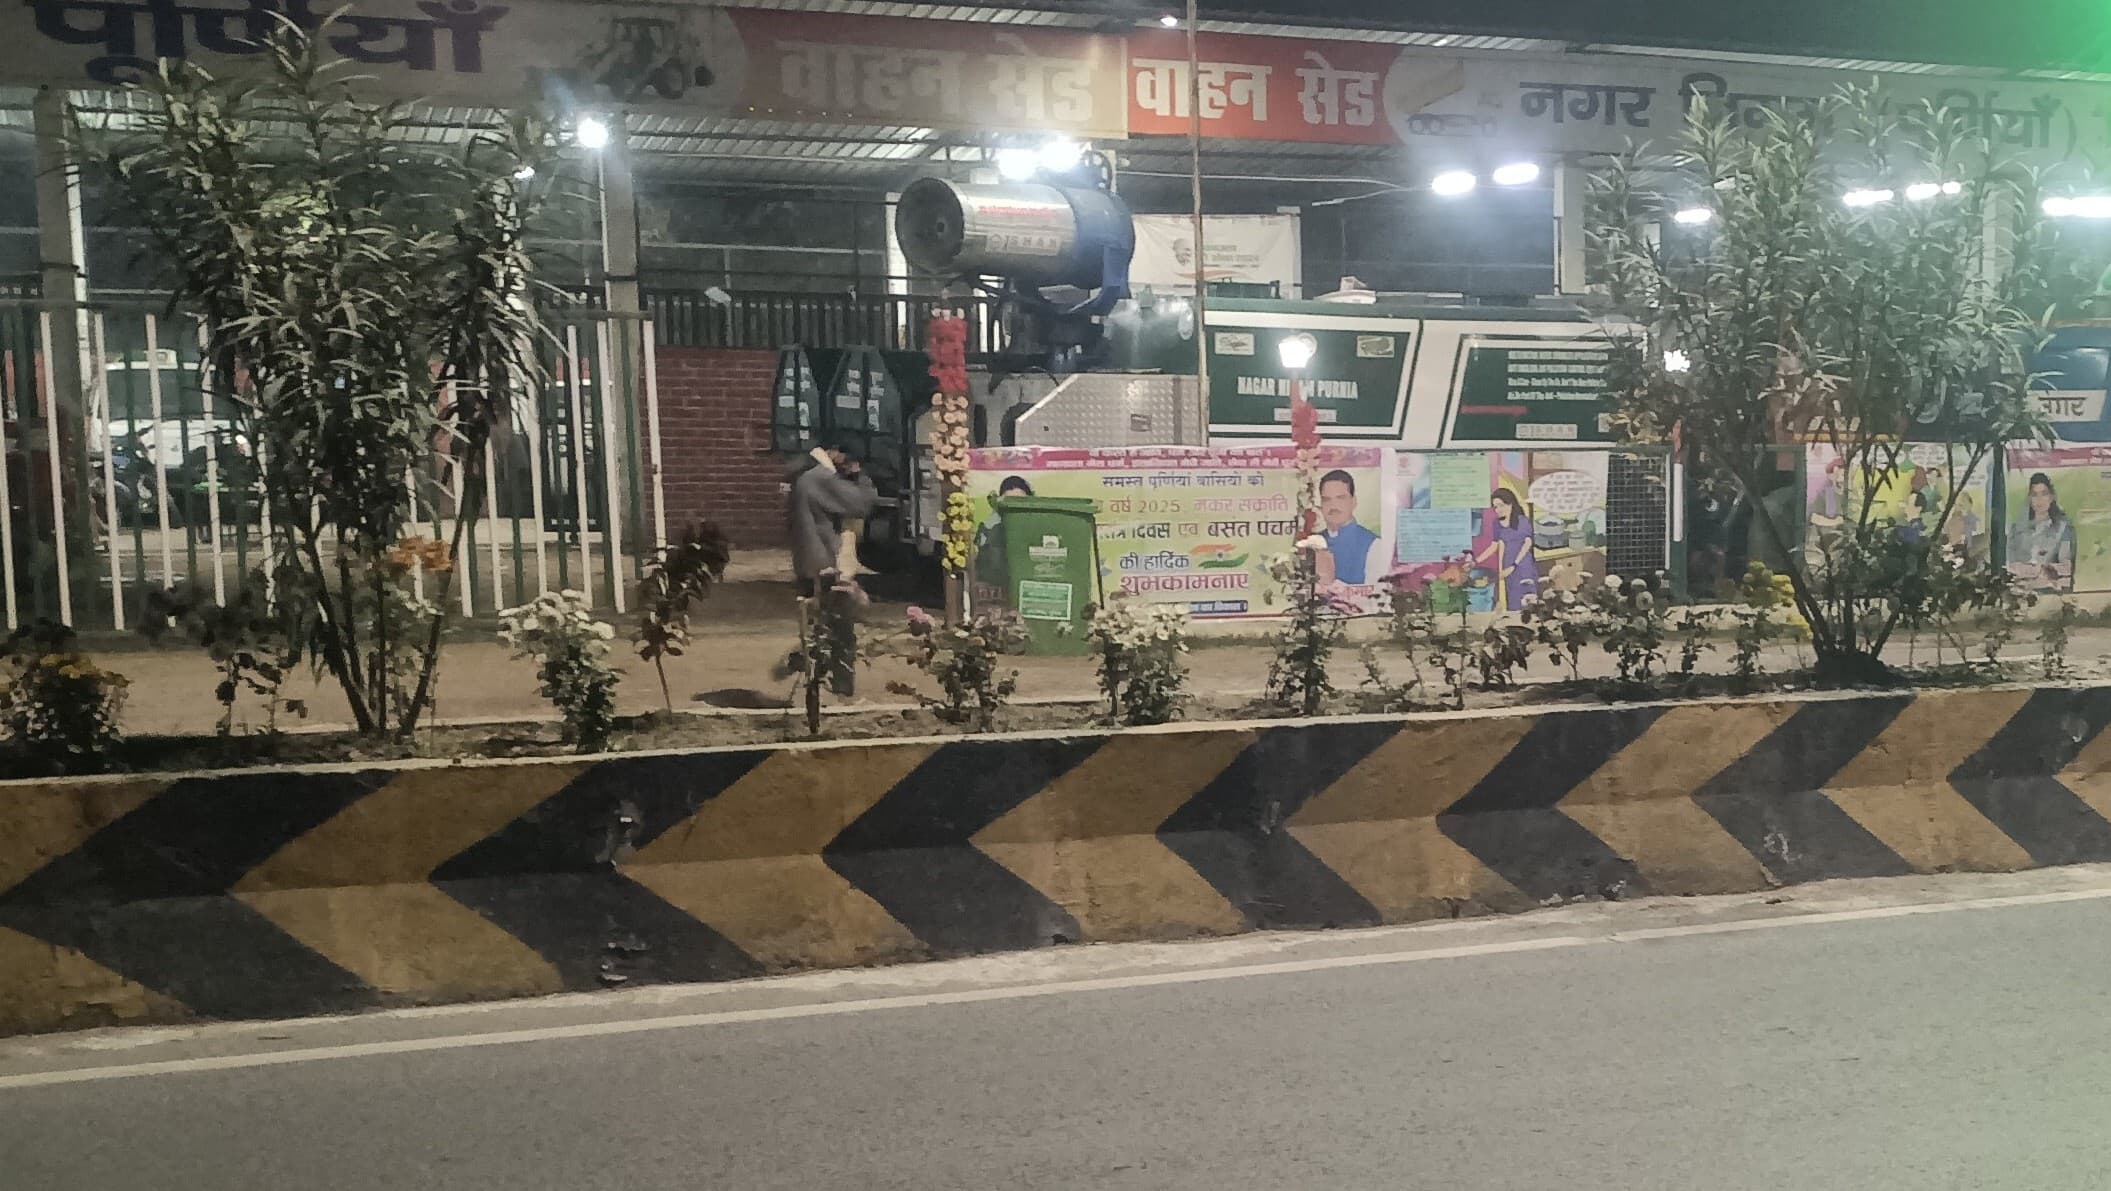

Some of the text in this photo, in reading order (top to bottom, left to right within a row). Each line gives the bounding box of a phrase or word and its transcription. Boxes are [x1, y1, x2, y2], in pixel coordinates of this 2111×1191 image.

[1132, 50, 1379, 127] वाहन सेड
[1519, 81, 1657, 128] नगर
[1237, 376, 1359, 400] NAGAR NIM PURNIA
[1138, 500, 1180, 513] 2025
[1257, 514, 1299, 537] पंचम
[1144, 550, 1190, 571] हार्दिक
